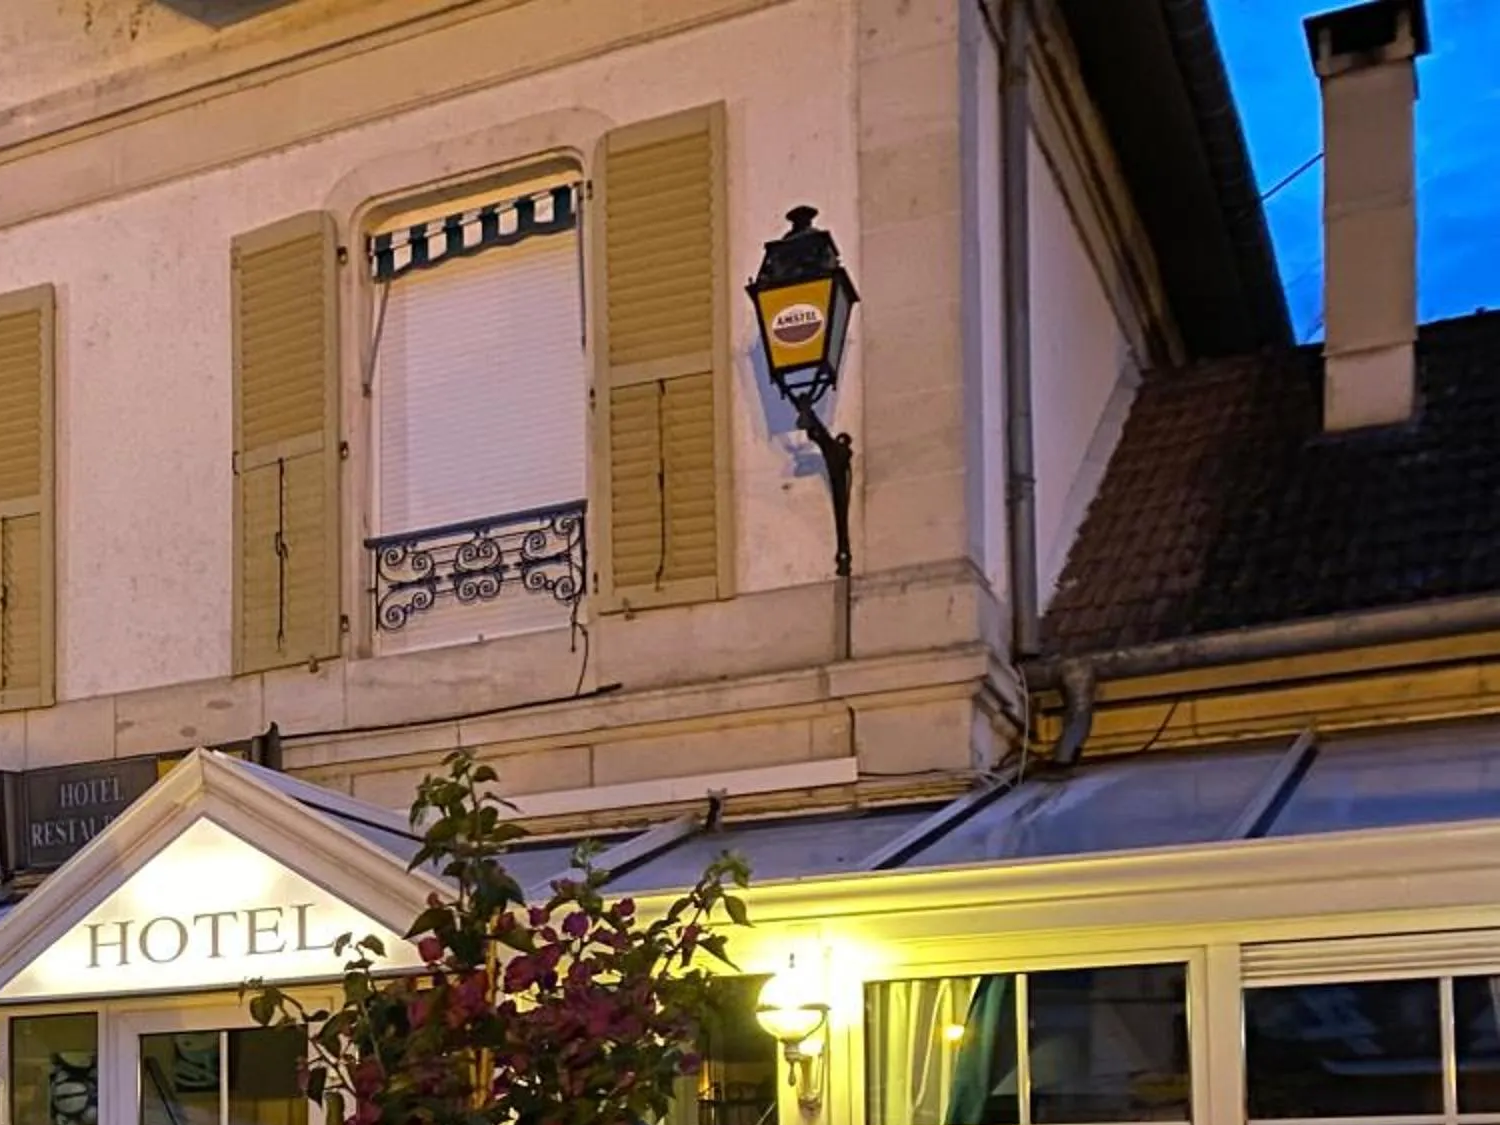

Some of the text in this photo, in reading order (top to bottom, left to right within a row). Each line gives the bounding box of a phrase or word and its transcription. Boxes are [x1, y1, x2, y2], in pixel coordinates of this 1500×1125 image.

[60, 775, 125, 810] HOTEL
[30, 816, 115, 849] RESTAU
[83, 903, 335, 969] HOTEL
